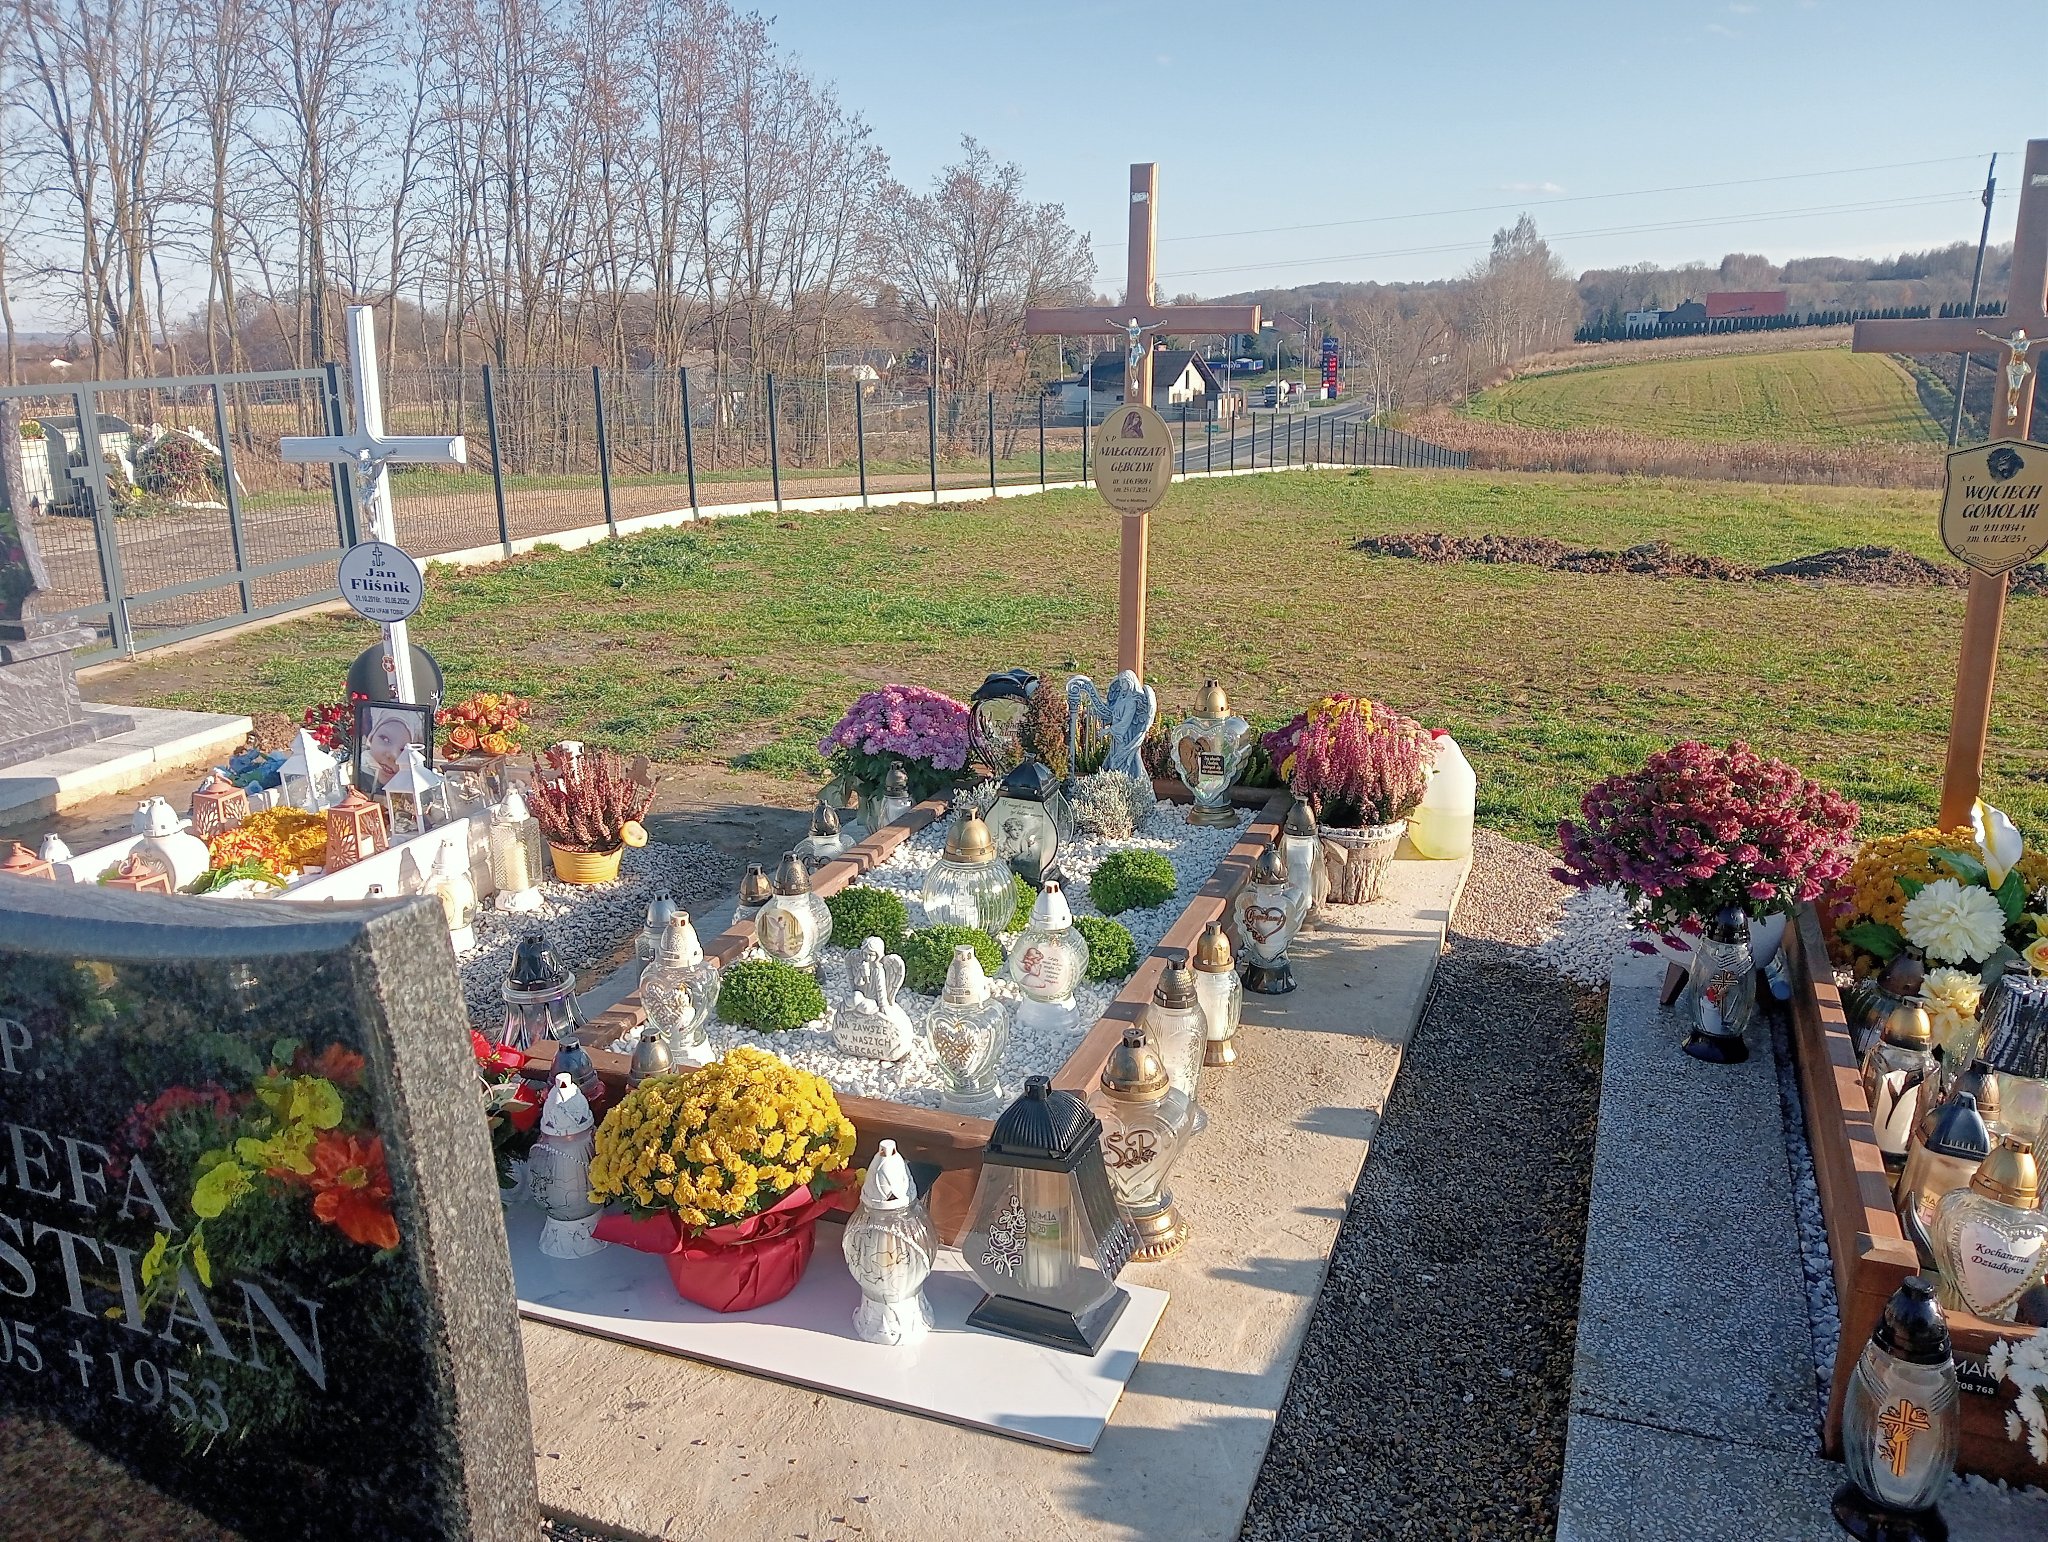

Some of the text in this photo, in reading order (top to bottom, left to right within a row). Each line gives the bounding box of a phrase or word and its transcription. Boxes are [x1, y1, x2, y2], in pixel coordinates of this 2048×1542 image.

[1099, 446, 1167, 457] MAŁGORZATA
[1110, 462, 1154, 473] GĘBCZYK
[1965, 485, 2043, 501] WOJCIECH
[1962, 503, 2040, 519] GOMOLAK
[365, 568, 396, 578] Jan
[351, 578, 411, 593] Fliśnik
[838, 1020, 888, 1036] NA ZAWSZE
[852, 1035, 891, 1048] NASZYCH
[843, 1044, 884, 1057] SERCACH
[0, 1121, 182, 1233] EFA
[1975, 1243, 2029, 1264] Kochanemu
[1970, 1255, 2026, 1275] Dziadkowi
[105, 1350, 229, 1435] 1953
[1975, 1385, 1995, 1395] 768
